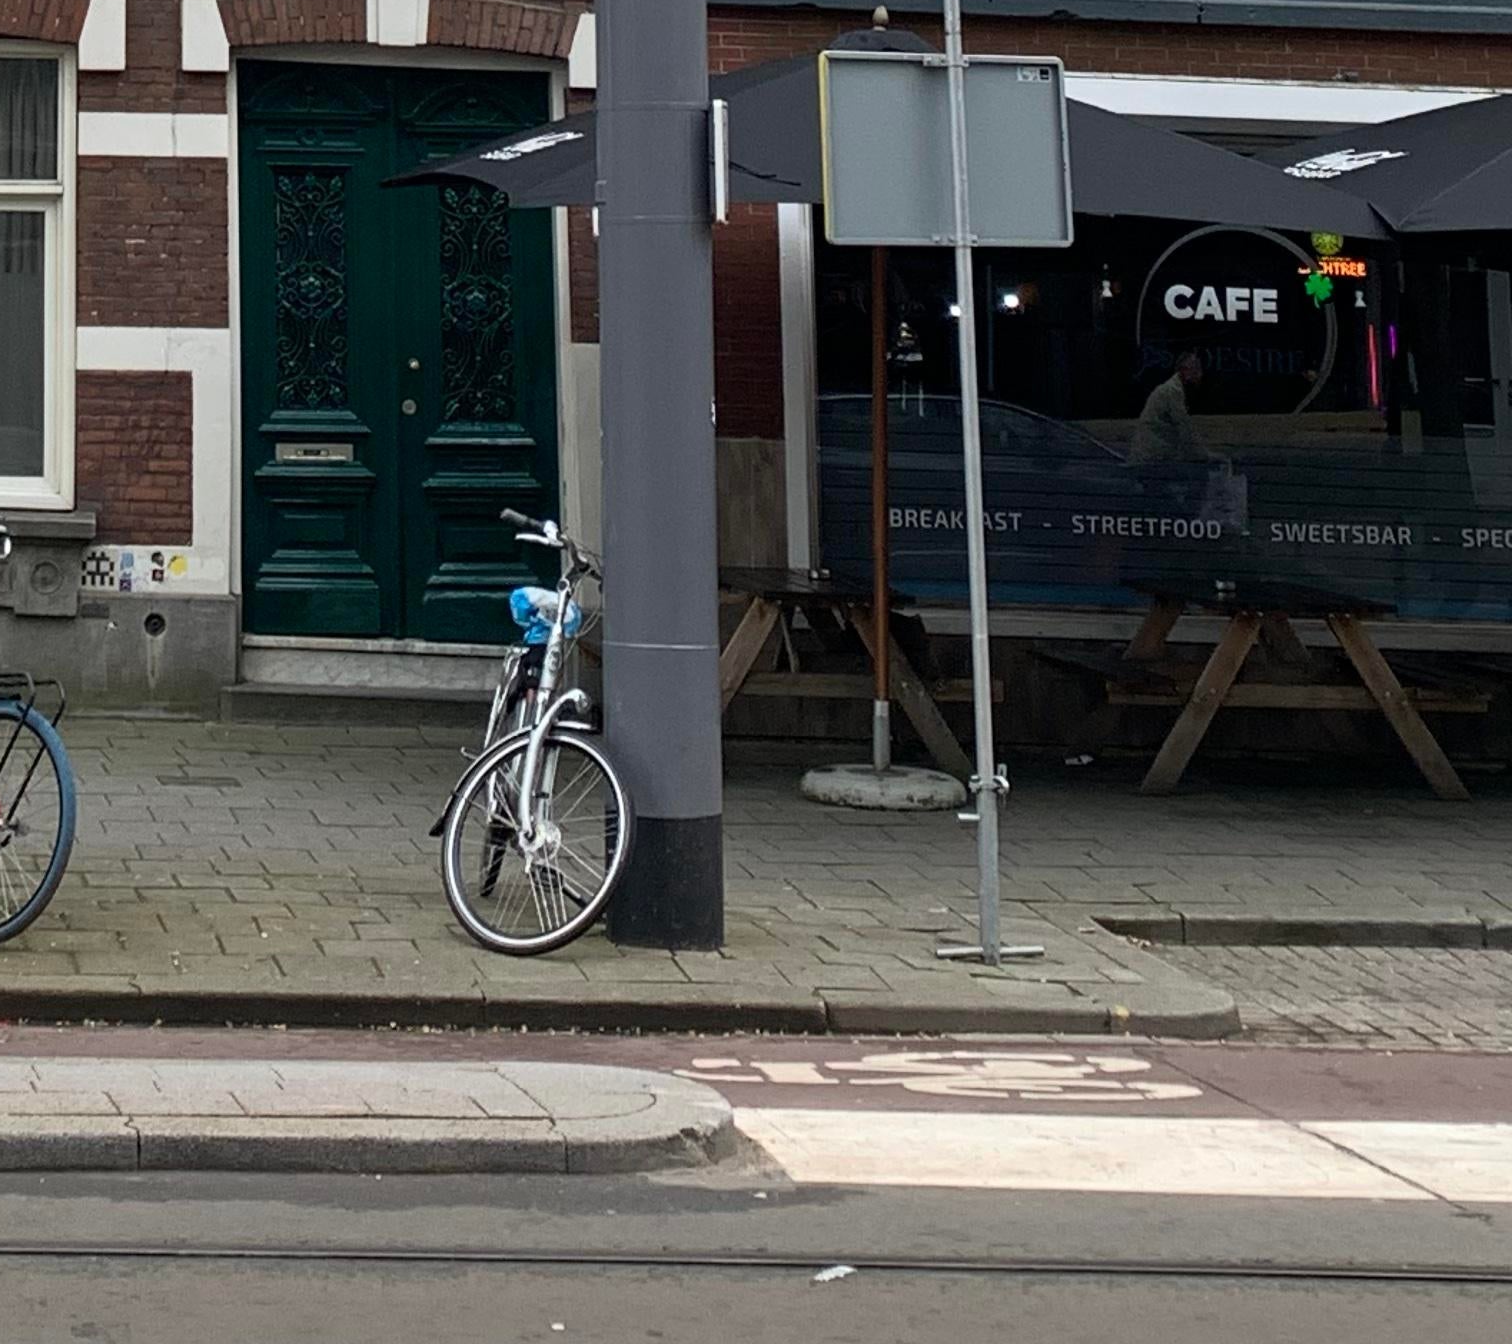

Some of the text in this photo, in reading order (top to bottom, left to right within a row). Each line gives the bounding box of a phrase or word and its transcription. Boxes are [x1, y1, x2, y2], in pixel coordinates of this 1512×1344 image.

[1163, 283, 1279, 324] CAFE
[888, 507, 1023, 532] BREAKAST
[1071, 514, 1222, 540] STREETFOOD
[1270, 522, 1413, 546] SWEETSBAR
